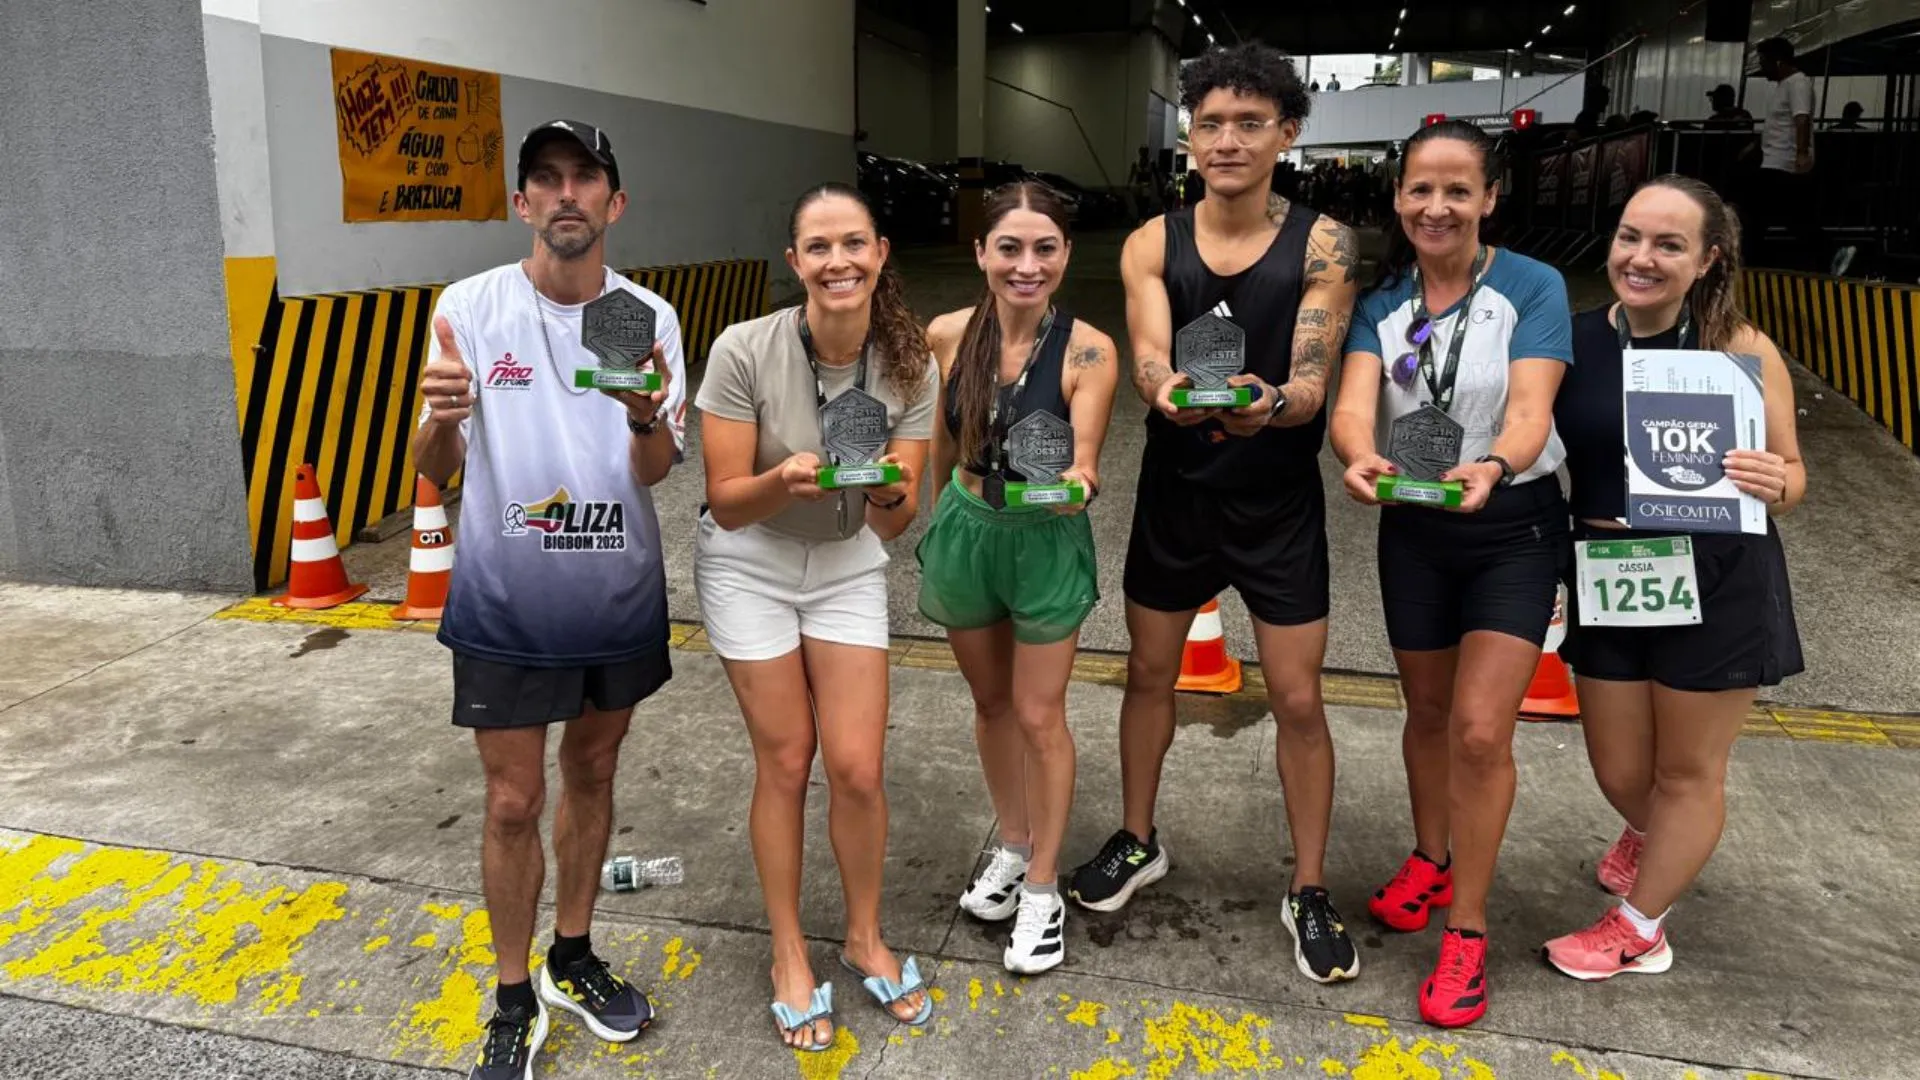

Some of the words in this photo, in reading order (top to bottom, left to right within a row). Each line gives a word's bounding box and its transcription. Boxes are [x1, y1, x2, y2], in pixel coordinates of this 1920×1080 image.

[415, 71, 459, 103] CALDO
[359, 98, 396, 148] TEM
[418, 105, 430, 121] DE
[432, 106, 457, 121] CANA
[397, 126, 445, 159] ÁGUA
[406, 160, 419, 176] DE
[425, 161, 449, 177] COCO
[378, 190, 389, 214] E
[393, 184, 463, 212] BRAZUCA
[1686, 421, 1721, 431] GERAL
[1645, 427, 1717, 454] 10K
[1651, 451, 1714, 466] FEMININO
[544, 502, 625, 533] OLIZA
[1639, 502, 1733, 521] OSTEOVITTA
[543, 535, 594, 550] BIGBOM
[596, 535, 625, 550] 2023
[1593, 576, 1695, 613] 1254
